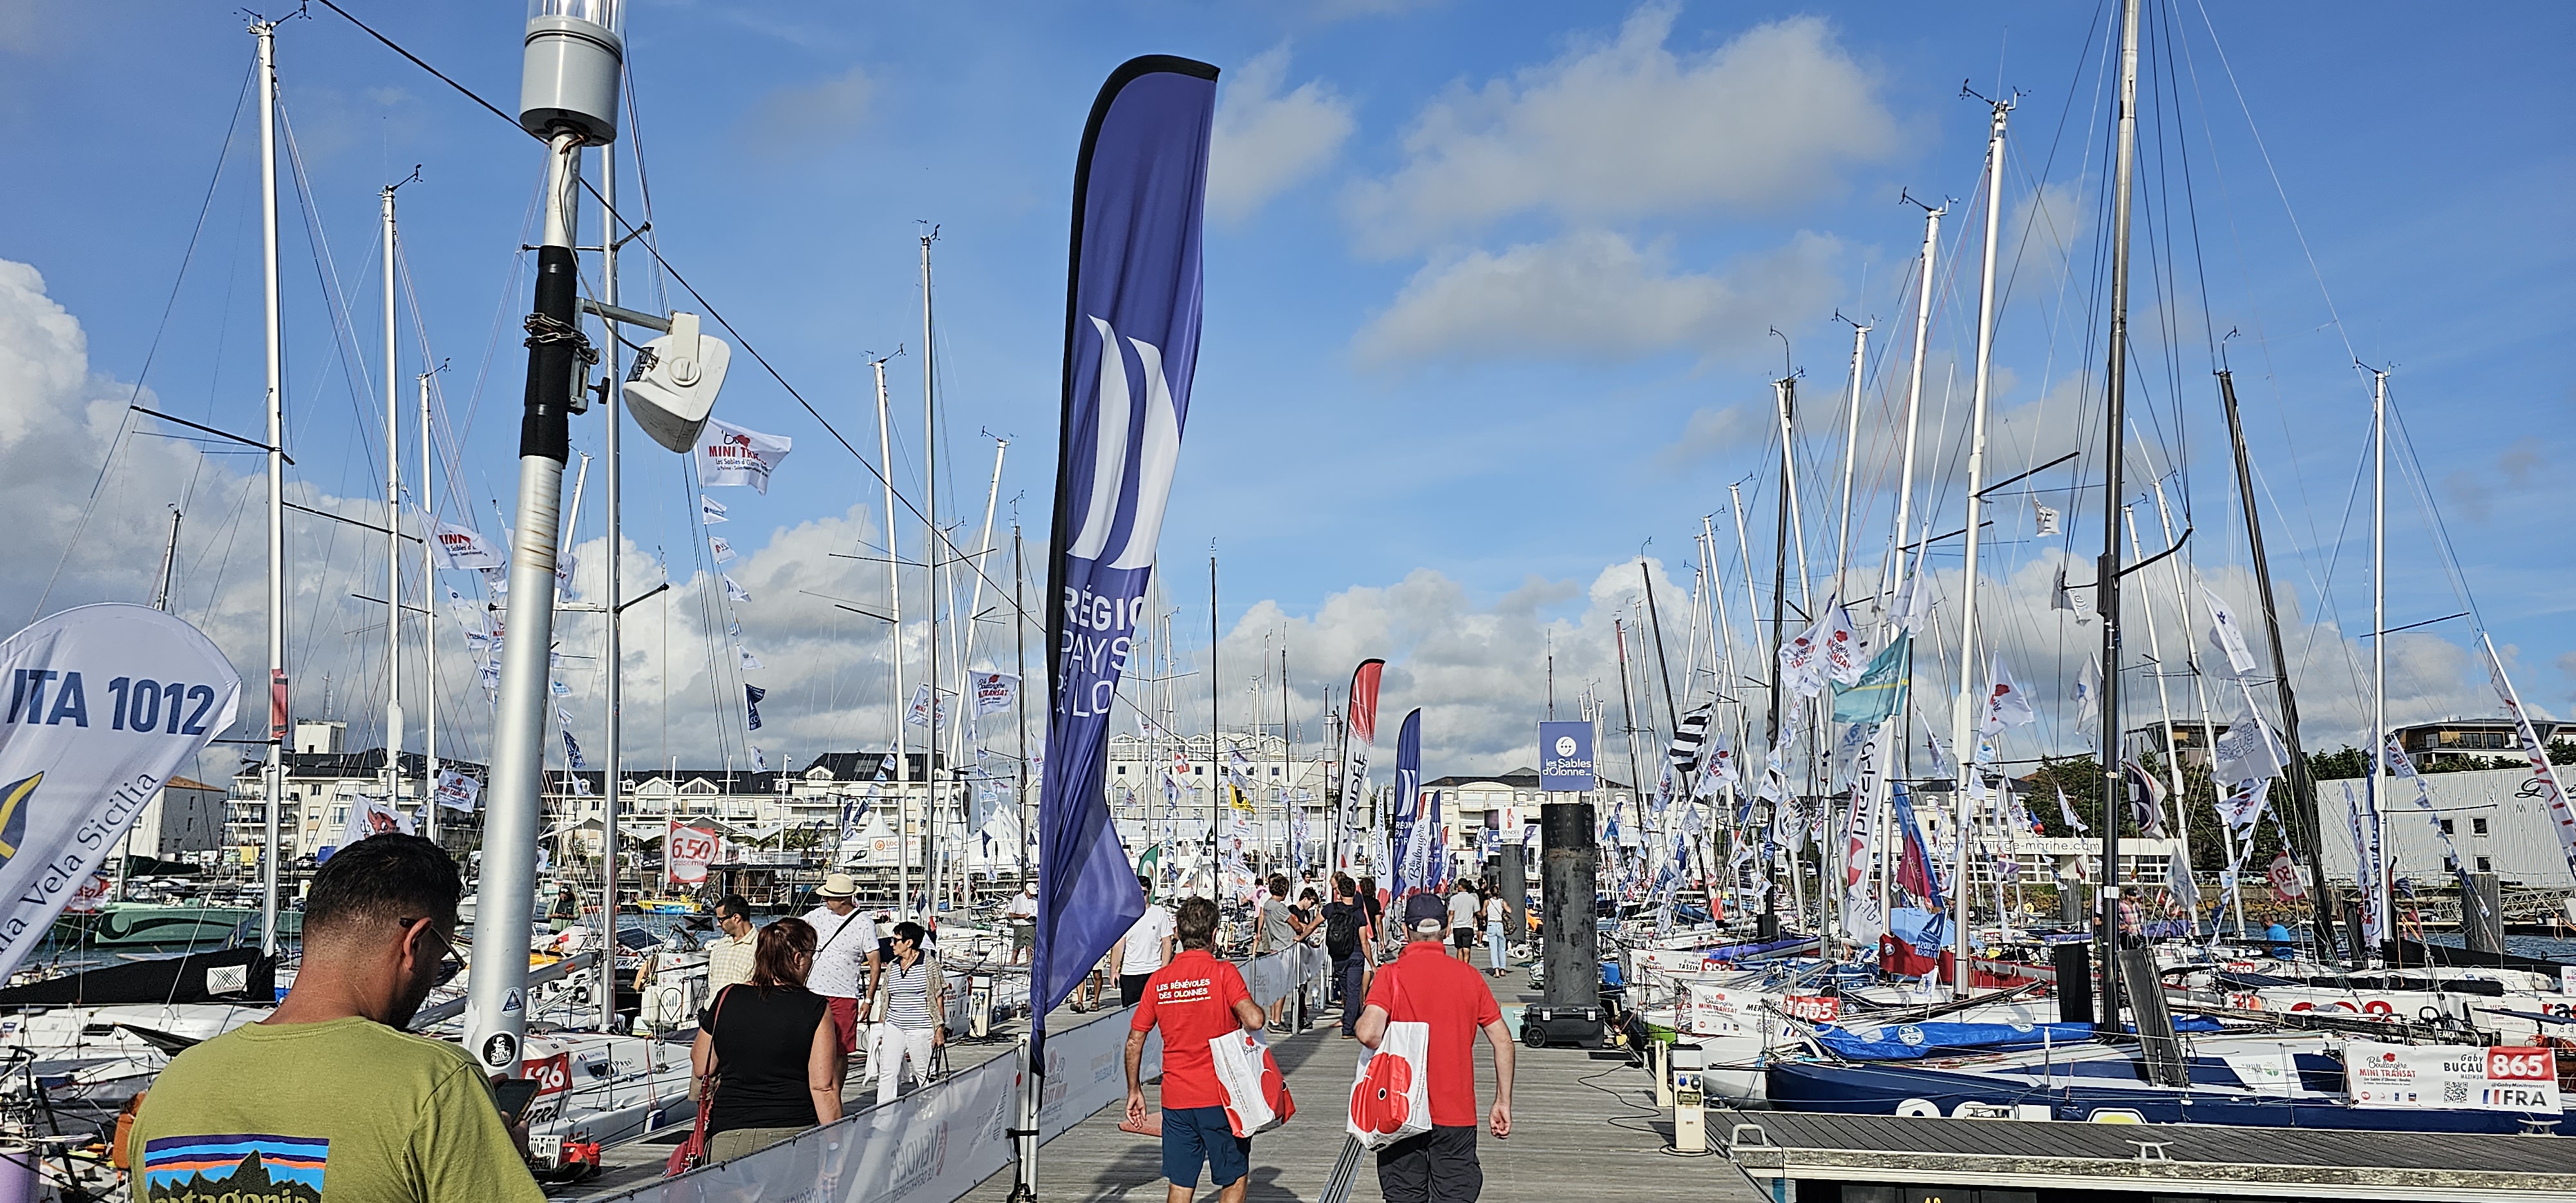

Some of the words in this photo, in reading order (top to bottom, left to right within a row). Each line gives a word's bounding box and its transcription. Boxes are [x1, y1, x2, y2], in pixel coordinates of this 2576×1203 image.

[708, 446, 735, 457] MINI
[6, 668, 88, 728] ITA
[108, 676, 215, 735] 1012
[1558, 758, 1592, 768] Sables
[1542, 767, 1586, 777] d'Olonne
[18, 854, 86, 906] Vela
[77, 773, 160, 851] Sicilia
[672, 838, 711, 859] 6.50
[1408, 823, 1426, 881] Boulangère
[1156, 983, 1168, 992] LES
[1170, 978, 1211, 989] BÉNÉVOLES
[1173, 988, 1208, 998] OLONNES
[1713, 1005, 1738, 1014] TRANSAT
[2366, 1056, 2408, 1072] Boulangère
[2461, 1054, 2484, 1064] Gaby
[2443, 1063, 2483, 1073] BUCAU
[2492, 1054, 2544, 1077] 865
[2380, 1069, 2416, 1077] TRANSAT
[2503, 1090, 2548, 1107] FRA
